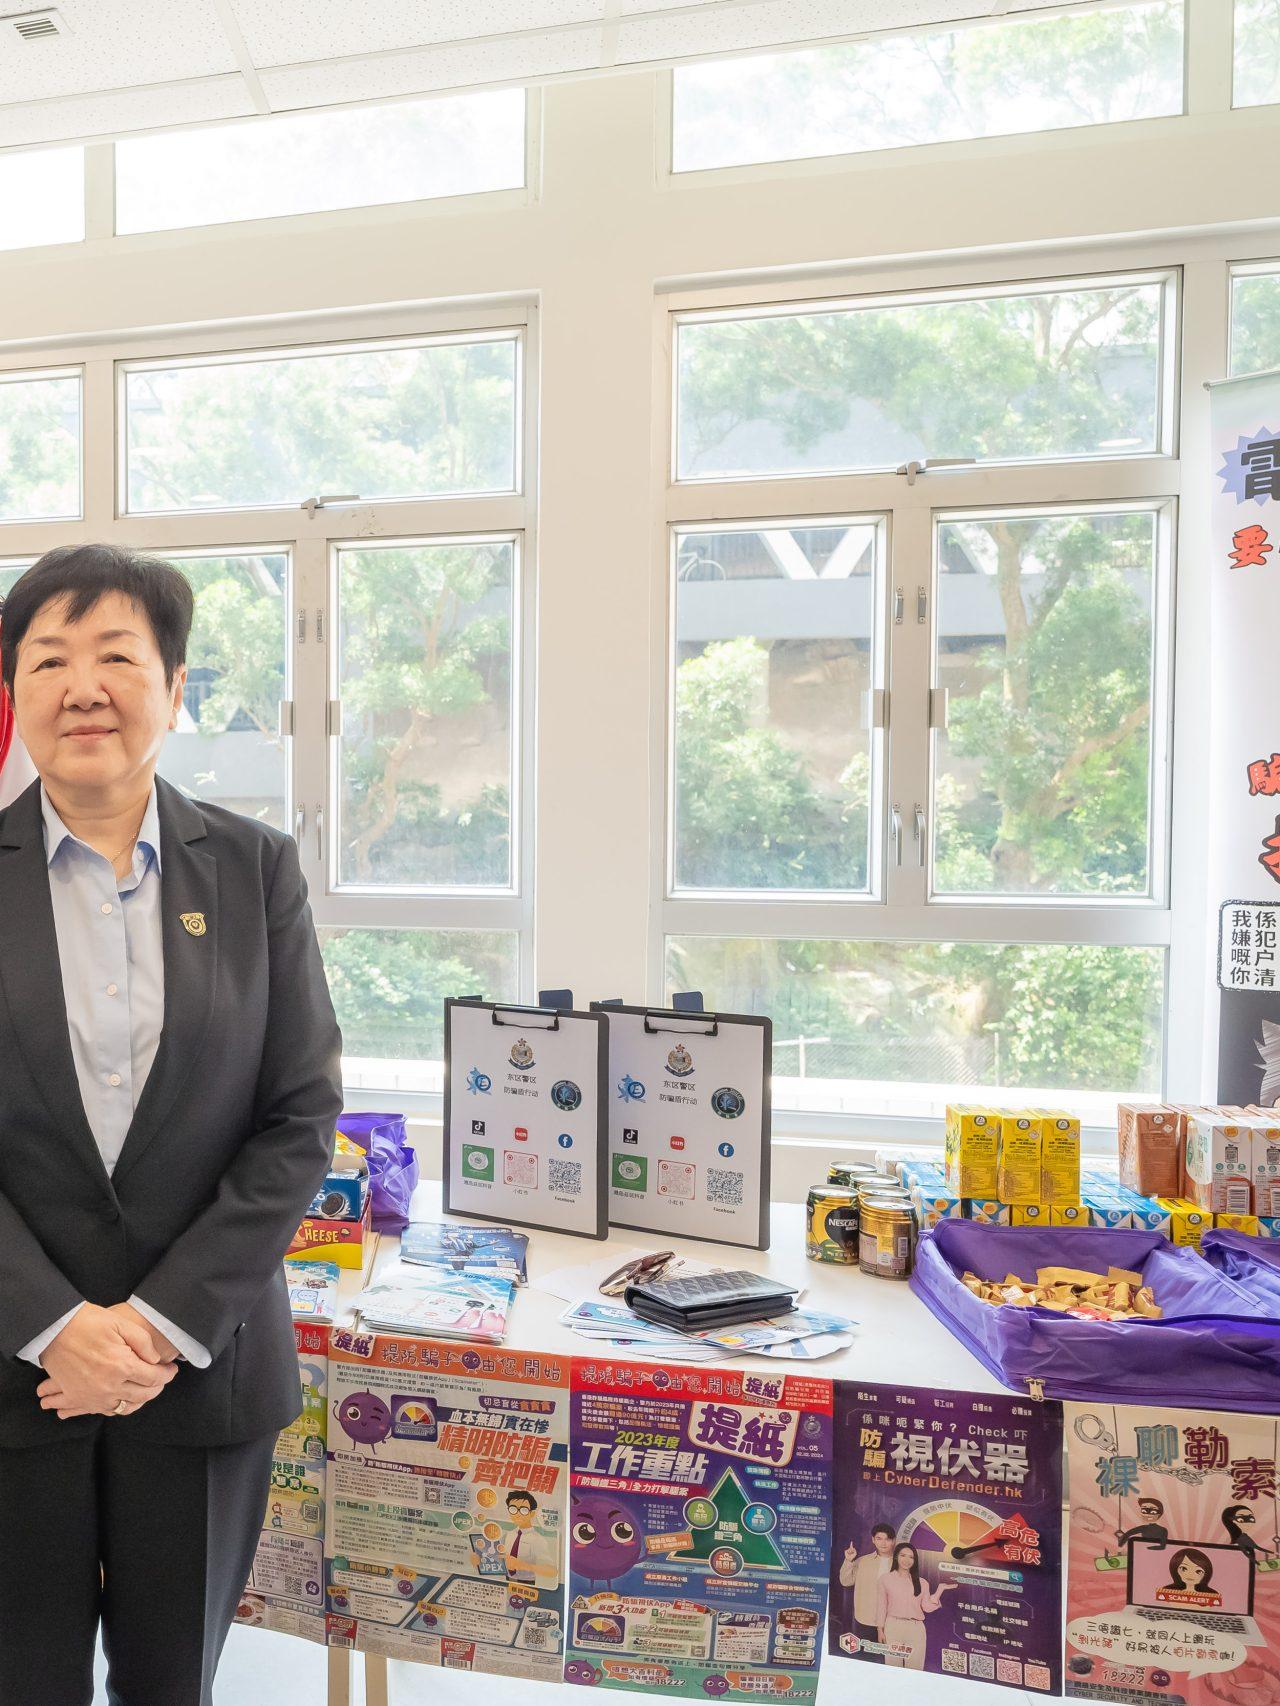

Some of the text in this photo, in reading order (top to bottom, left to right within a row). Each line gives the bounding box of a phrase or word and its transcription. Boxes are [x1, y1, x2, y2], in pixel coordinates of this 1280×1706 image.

[381, 1343, 561, 1382] 提防騙子 由您開始
[580, 1365, 647, 1387] 提防騙子
[437, 1424, 552, 1465] 精明防騙
[614, 1431, 681, 1449] 2023年度
[696, 1404, 787, 1462] 提紙
[968, 1424, 1009, 1440] Check
[859, 1427, 887, 1469] 防騙
[889, 1431, 1031, 1485] 視伏器
[575, 1441, 709, 1484] 工作重點
[471, 1458, 560, 1495] 齊把關
[883, 1470, 1024, 1500] CyberDefender.hk
[999, 1519, 1041, 1547] 高危
[480, 1563, 503, 1571] JPEX
[1003, 1543, 1042, 1566] 有伏
[1167, 1593, 1210, 1605] SCAM ALERT
[656, 1677, 687, 1687] 18222
[1101, 1669, 1146, 1686] 18222
[783, 1689, 816, 1699] 18222
